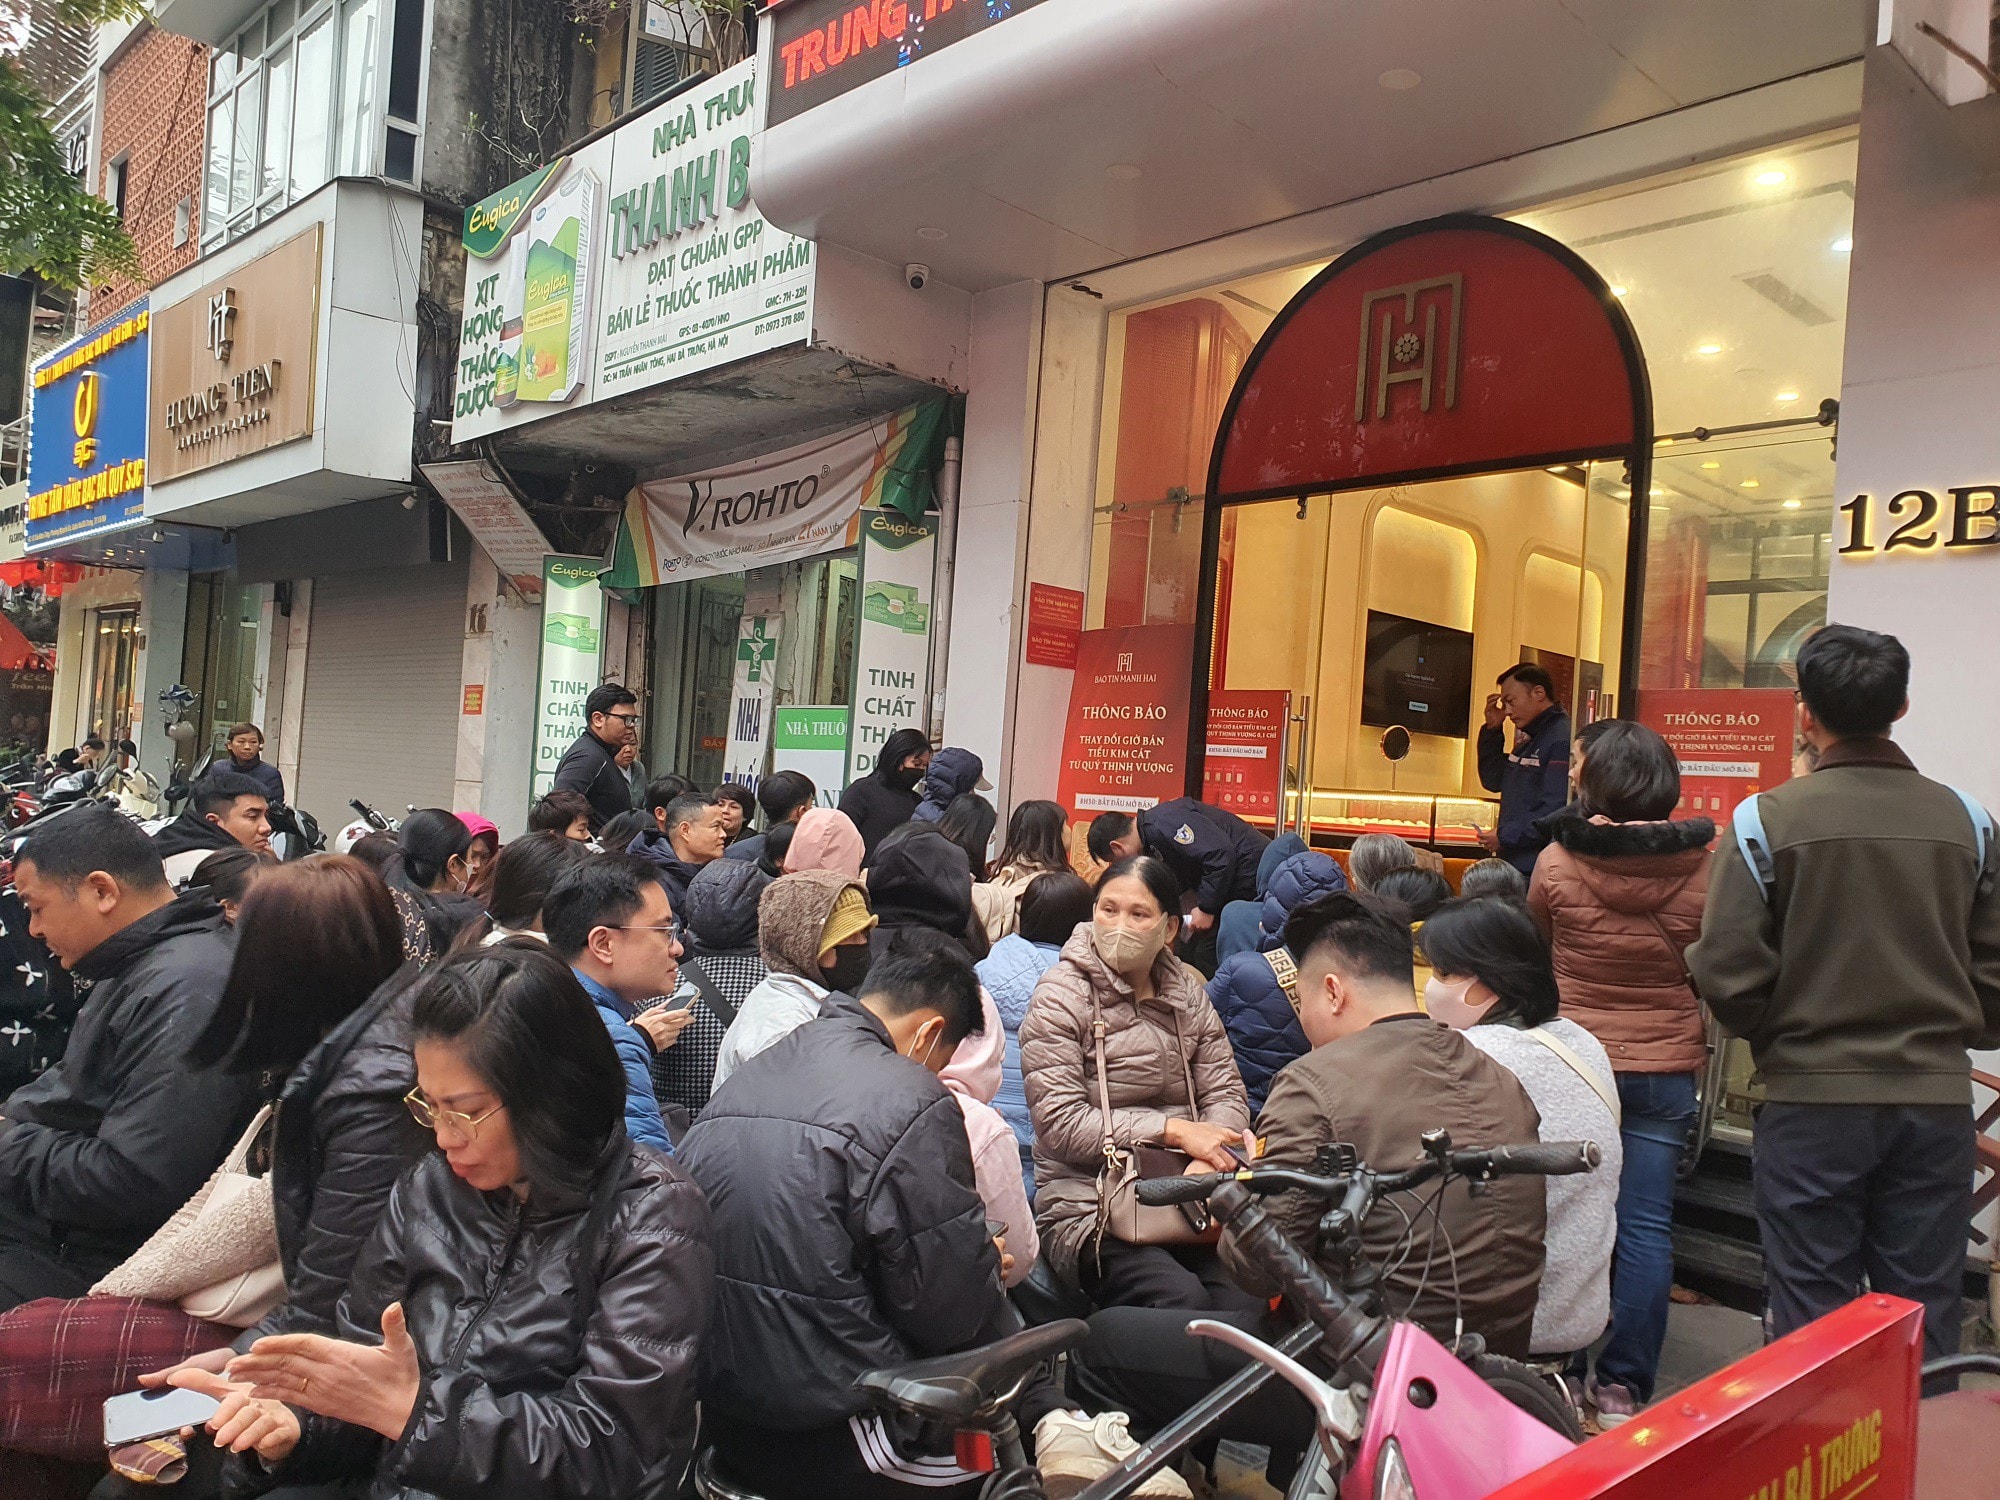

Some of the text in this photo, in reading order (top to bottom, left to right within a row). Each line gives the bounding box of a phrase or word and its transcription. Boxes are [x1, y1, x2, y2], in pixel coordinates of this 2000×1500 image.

[781, 0, 908, 89] TRUNG
[652, 104, 697, 158] NHÀ
[610, 148, 716, 260] THANH
[469, 196, 520, 233] Eugica
[648, 219, 763, 286] ĐẠT CHUẨN GPP
[475, 273, 500, 307] XỊT
[528, 273, 568, 300] Eugica
[607, 305, 634, 336] BÁN
[636, 293, 651, 326] LẺ
[656, 277, 702, 318] THUỐC
[707, 260, 758, 300] THÀNH
[762, 236, 810, 280] PHẨM
[783, 291, 791, 303] 7H
[463, 305, 504, 345] HỌNG
[461, 342, 499, 384] THẢO
[455, 380, 496, 418] DƯỢC
[871, 517, 928, 537] Eugica
[1839, 485, 2000, 554] 12B
[797, 521, 814, 540] 27
[551, 564, 598, 579] Eugica
[550, 680, 588, 695] TINH
[869, 668, 915, 689] TINH
[547, 700, 586, 717] CHẤT
[734, 688, 762, 742] NHÀ
[864, 694, 916, 717] CHẤT
[1082, 702, 1167, 720] THÔNG BÁO
[1210, 706, 1269, 719] THÔNG BÁO
[785, 717, 848, 736] NHÀ THUỐ
[1664, 711, 1760, 726] THÔNG BÁO
[1080, 732, 1165, 746] THAY ĐỔI GIỜ BÁN
[1741, 733, 1758, 742] KIM
[1088, 745, 1151, 759] TIỂU KIM CÁT
[1068, 759, 1174, 774] TỨ QUÝ THỊNH VƯỢNG
[1099, 774, 1113, 785] 0.1
[1138, 800, 1153, 809] BÁN
[1820, 1408, 1882, 1500] TRƯNG
